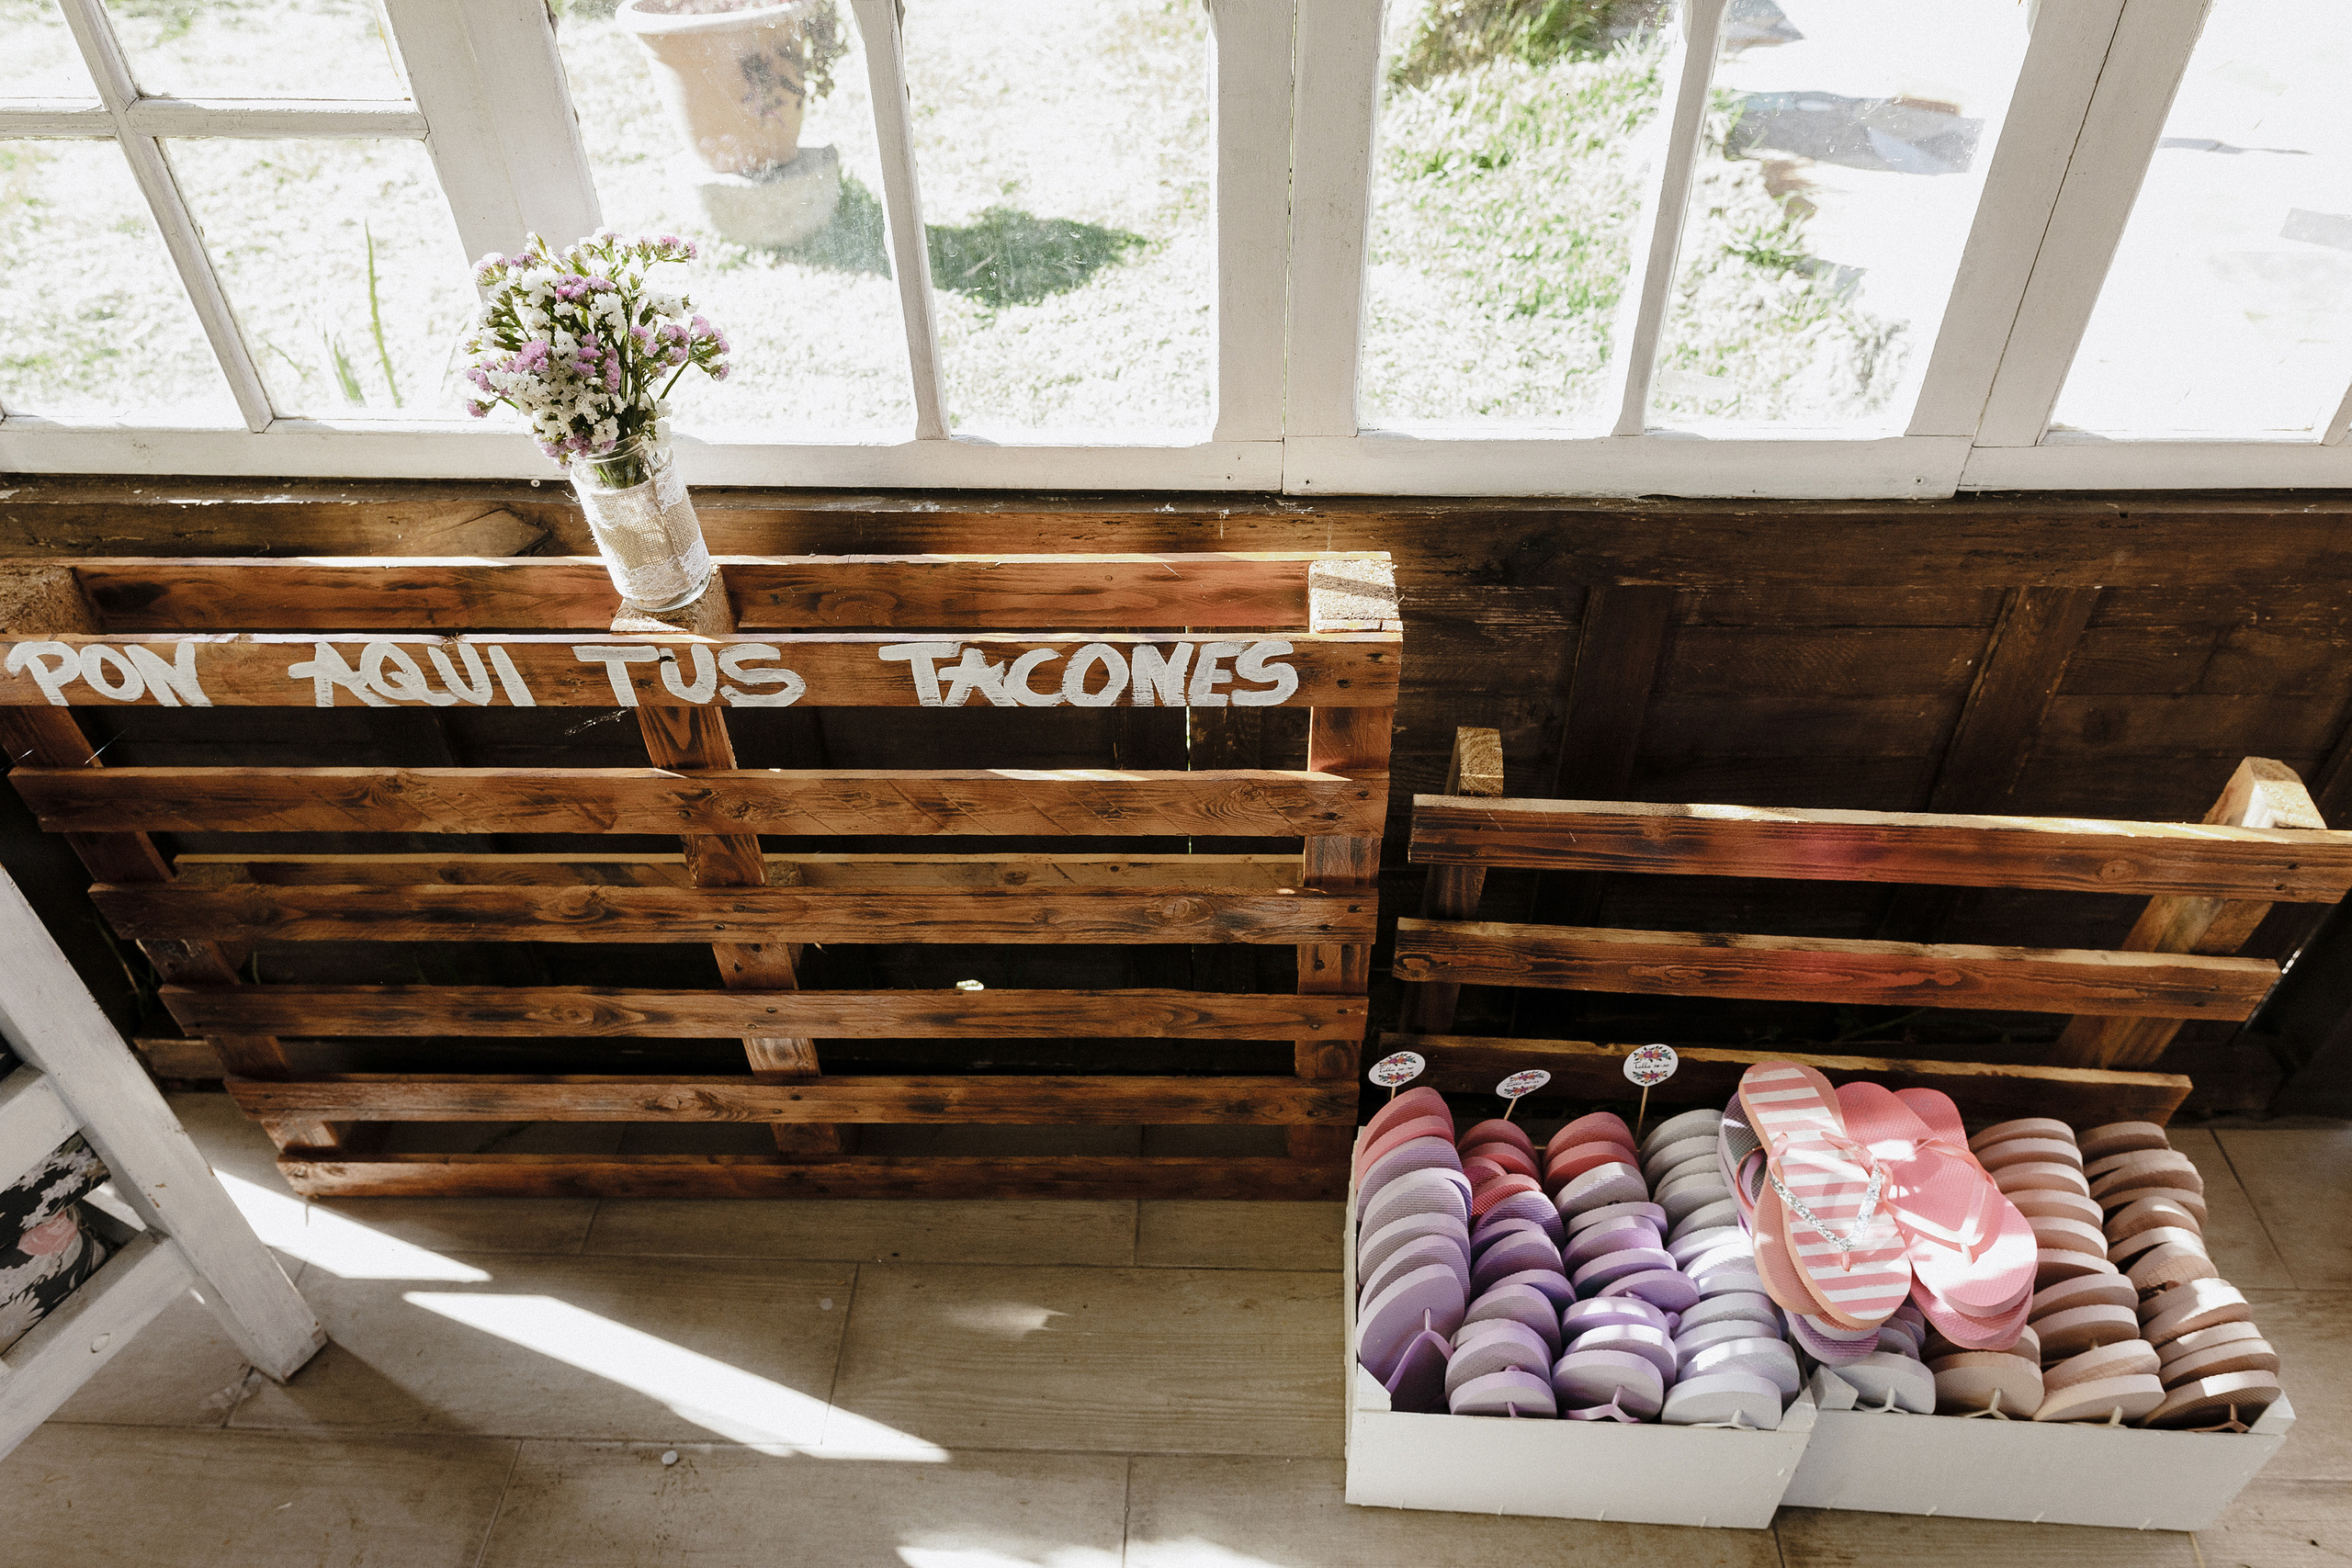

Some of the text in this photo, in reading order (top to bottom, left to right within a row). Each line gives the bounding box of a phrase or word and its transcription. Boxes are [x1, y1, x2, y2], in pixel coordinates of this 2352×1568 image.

[4, 640, 1299, 708] PON AQUI TUS TACONES
